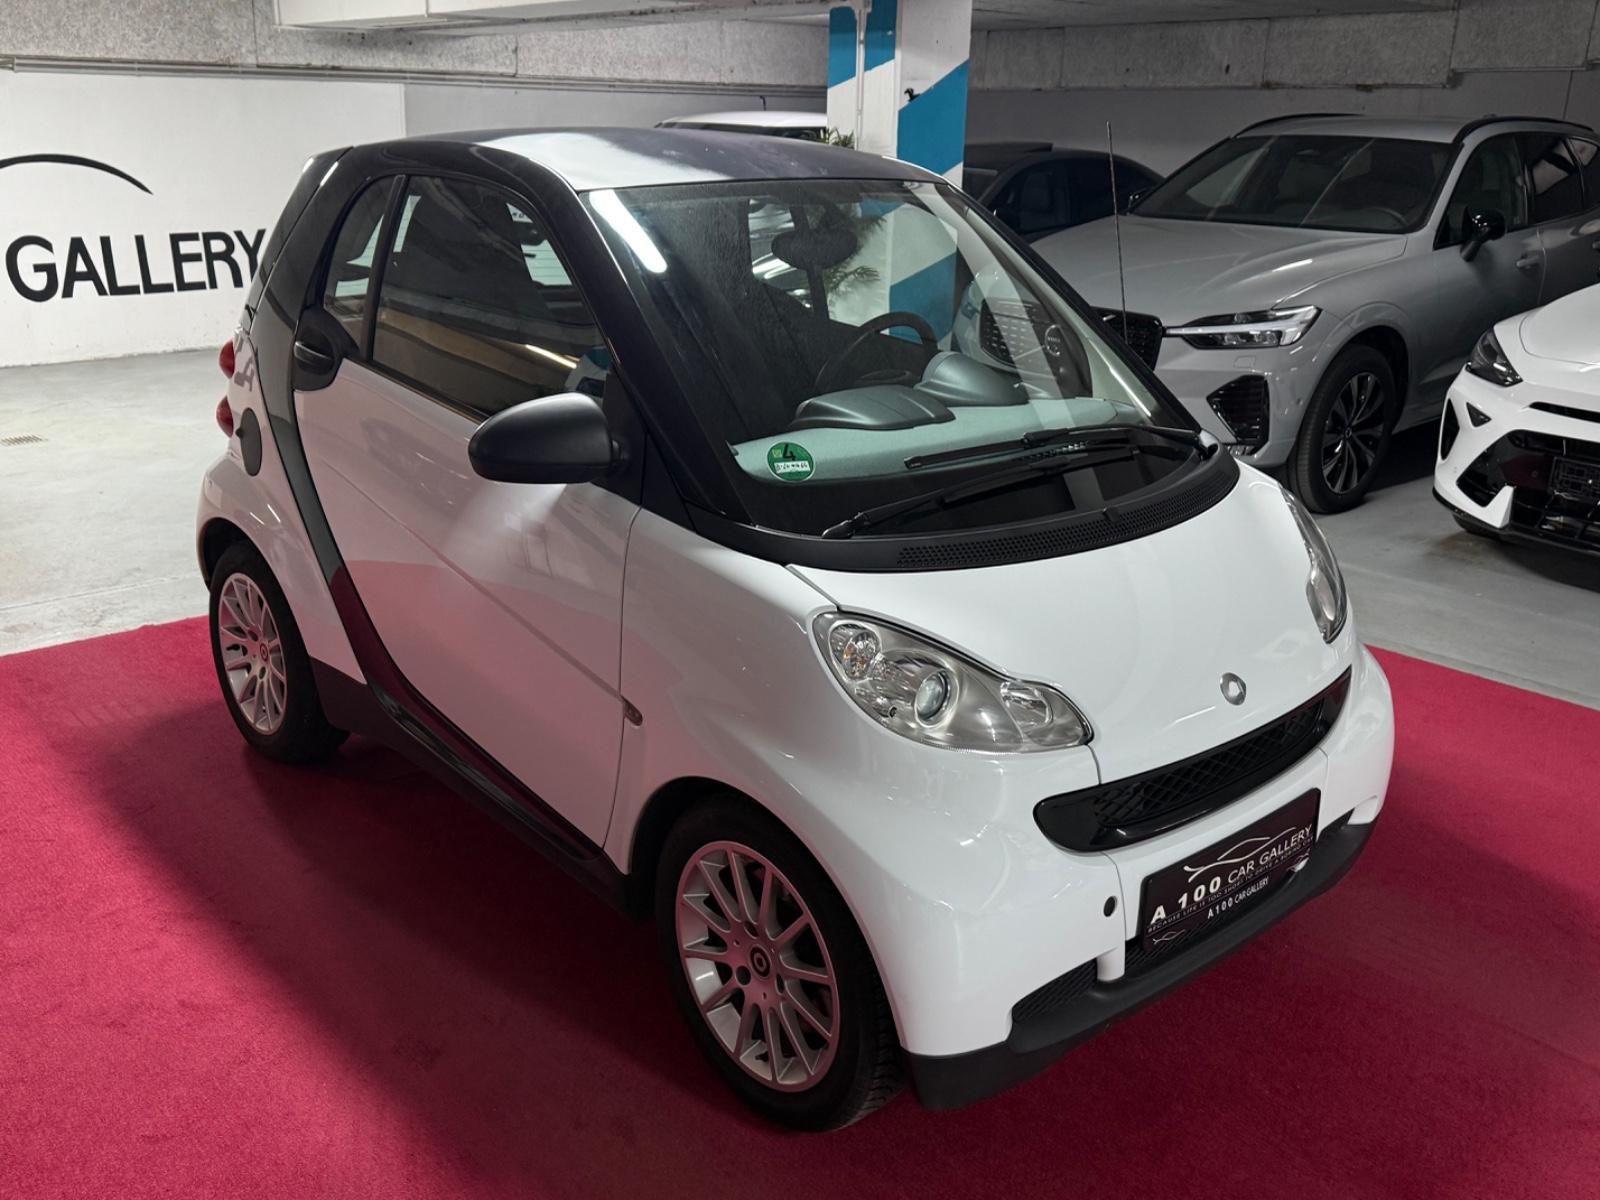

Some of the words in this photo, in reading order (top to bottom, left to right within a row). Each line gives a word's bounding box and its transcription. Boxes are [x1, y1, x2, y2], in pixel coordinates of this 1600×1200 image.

[5, 228, 267, 302] GALLERY
[783, 443, 796, 461] 4
[1150, 904, 1166, 925] A
[1178, 876, 1221, 909] 100
[1228, 860, 1255, 884] CAR
[1259, 823, 1313, 865] GALLERY
[1207, 908, 1215, 920] A
[1215, 896, 1234, 914] 100
[1234, 889, 1247, 904] CAR
[1246, 875, 1270, 897] GALLERY
